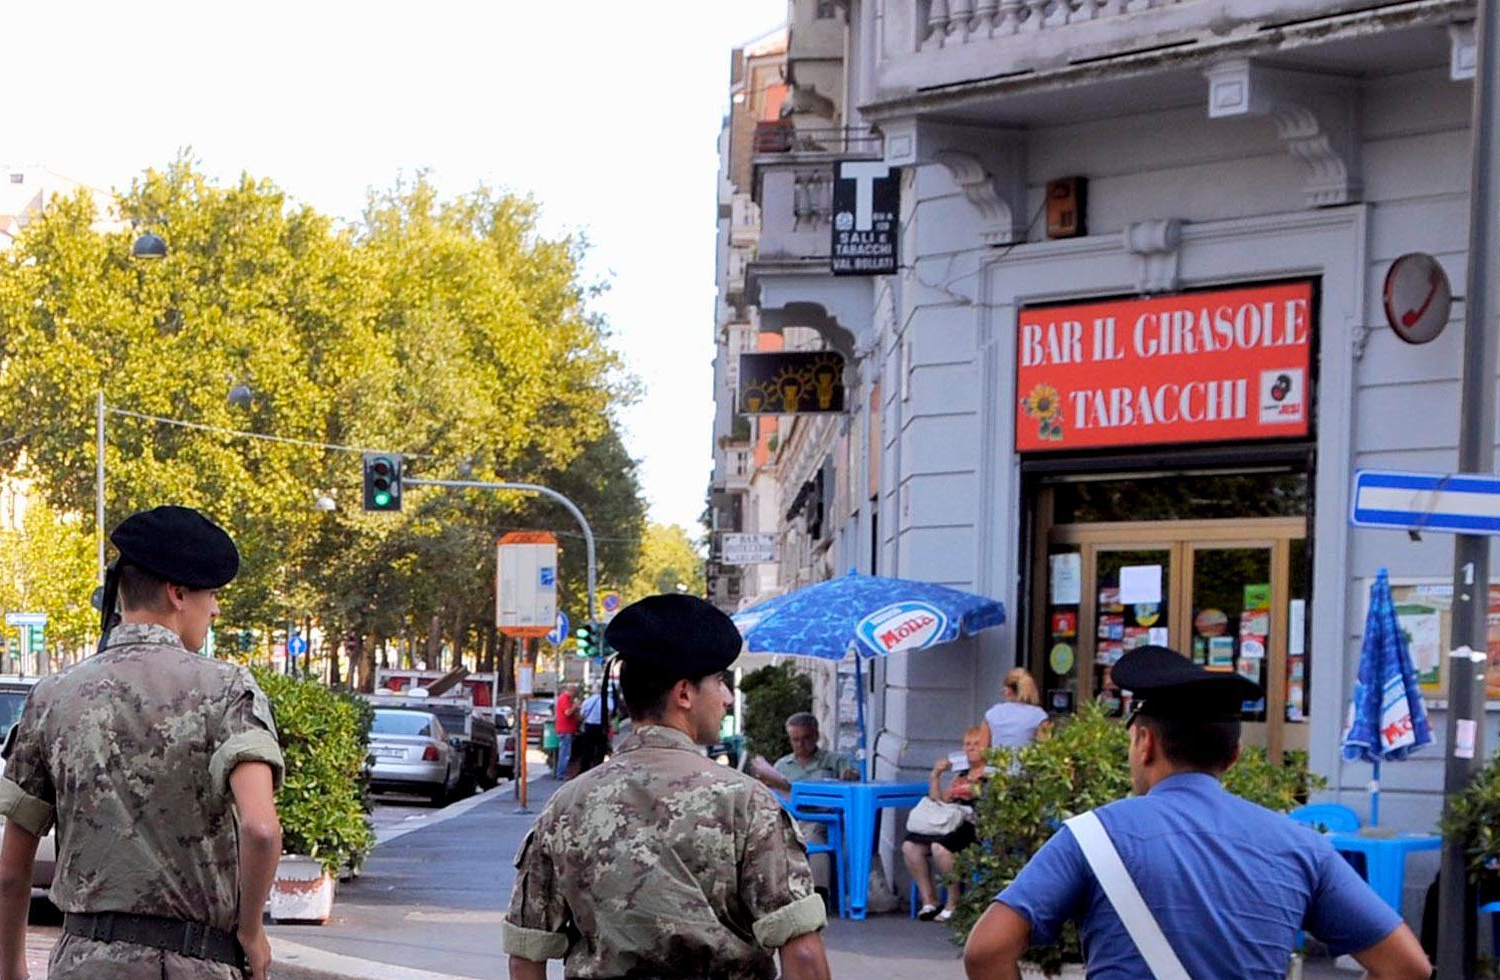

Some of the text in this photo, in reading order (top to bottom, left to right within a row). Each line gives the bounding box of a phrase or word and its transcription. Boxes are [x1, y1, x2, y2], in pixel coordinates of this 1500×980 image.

[841, 161, 889, 231] T
[836, 244, 892, 256] TABACCHI
[839, 231, 874, 243] SALI
[1022, 299, 1308, 367] BAR IL GIRASOLE
[1069, 378, 1247, 429] TABACCHI
